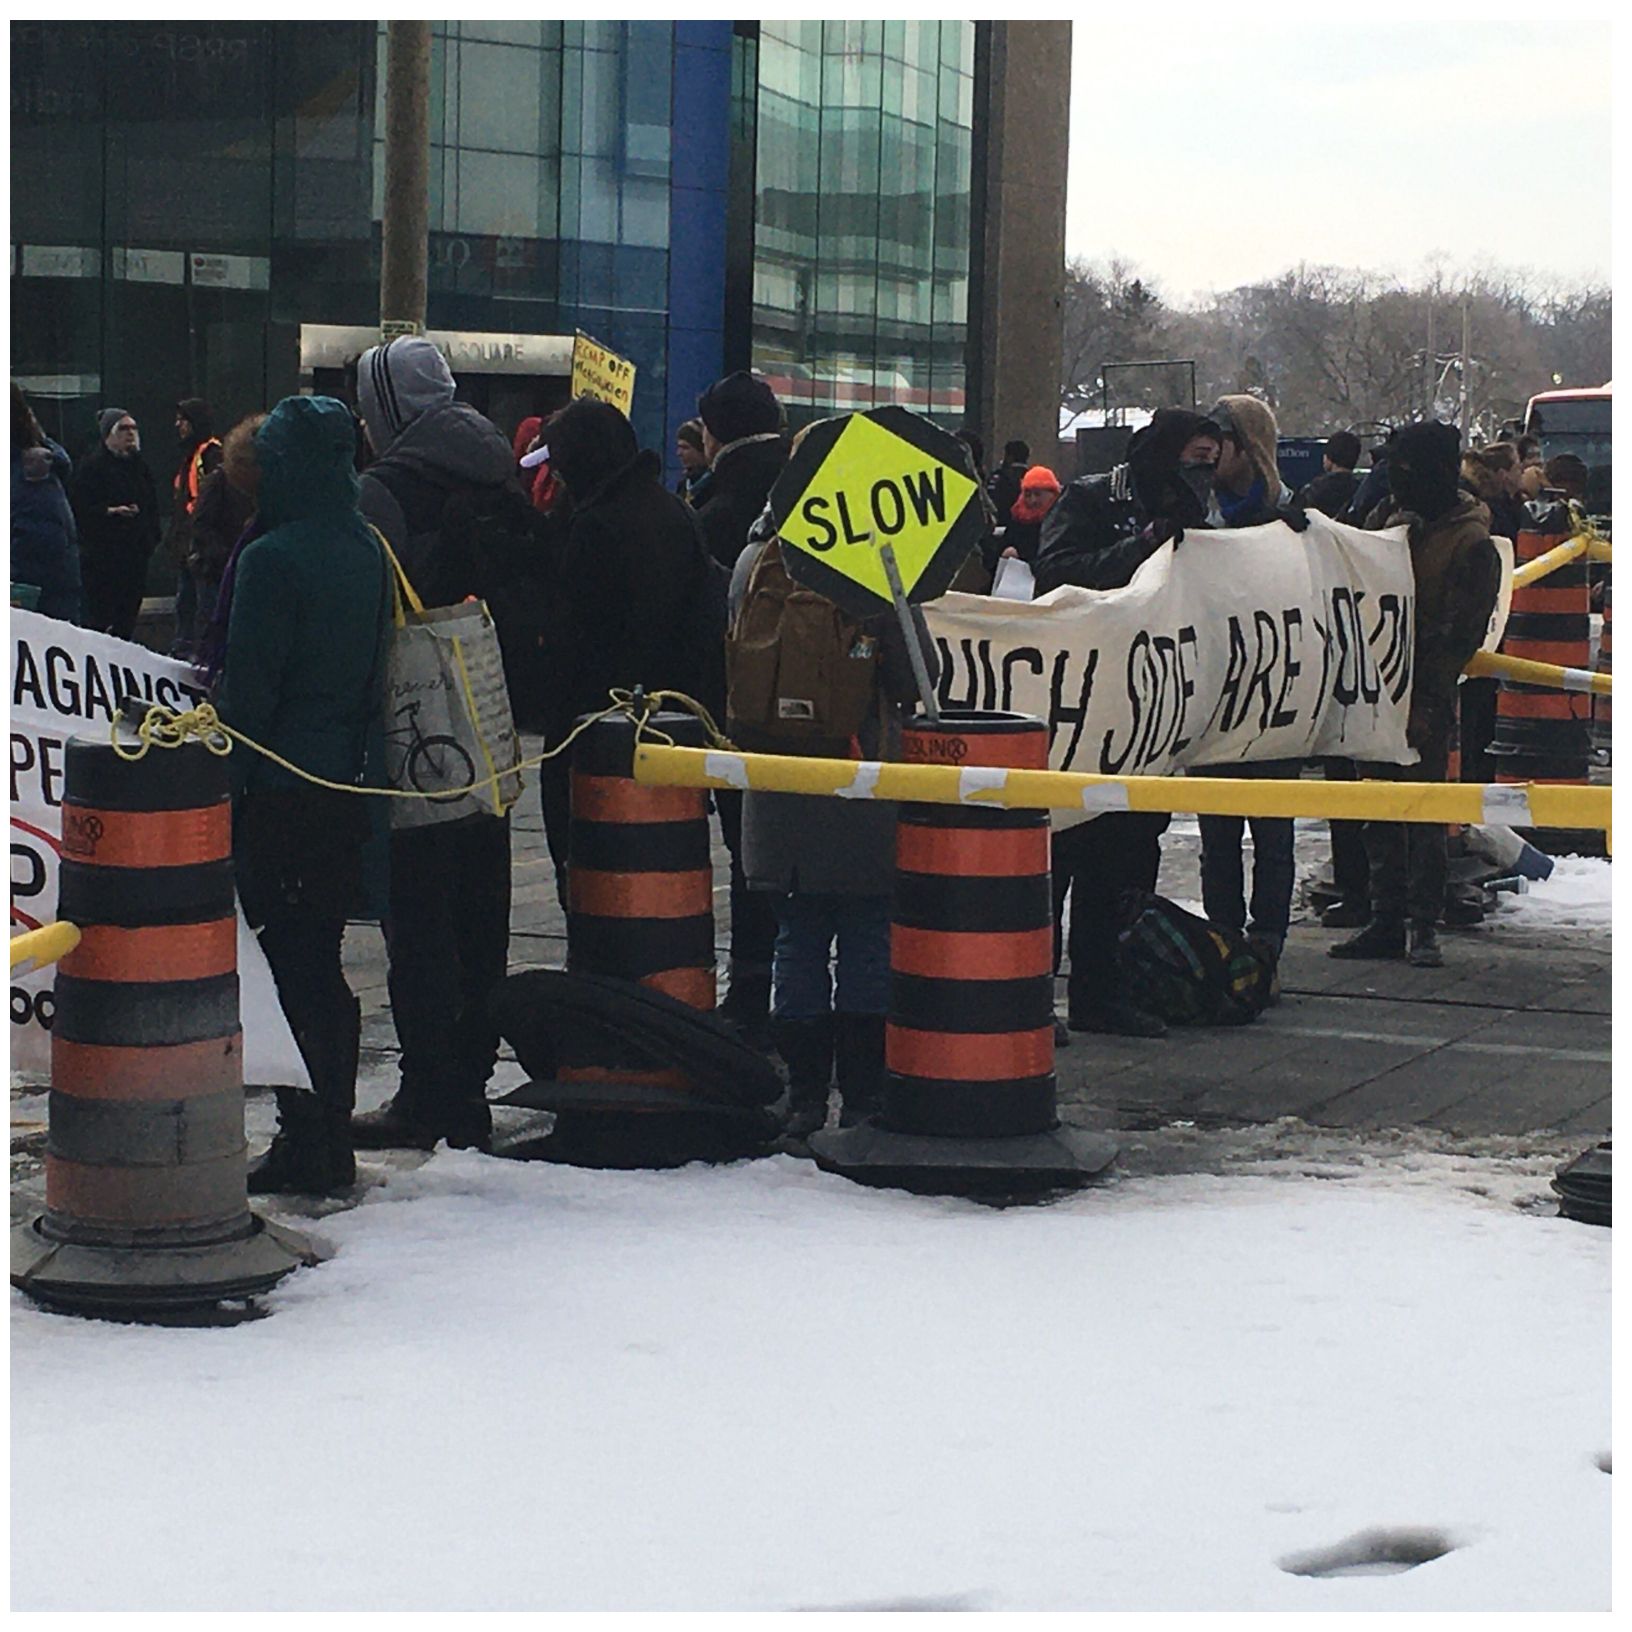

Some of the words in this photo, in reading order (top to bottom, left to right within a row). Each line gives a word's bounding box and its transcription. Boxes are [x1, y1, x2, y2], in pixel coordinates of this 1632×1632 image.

[454, 343, 524, 361] SQUARE
[609, 360, 630, 380] OFF
[802, 466, 946, 552] SLOW
[13, 639, 212, 723] AGAINST
[1099, 625, 1197, 776] SIDE
[1206, 608, 1303, 736] ARE
